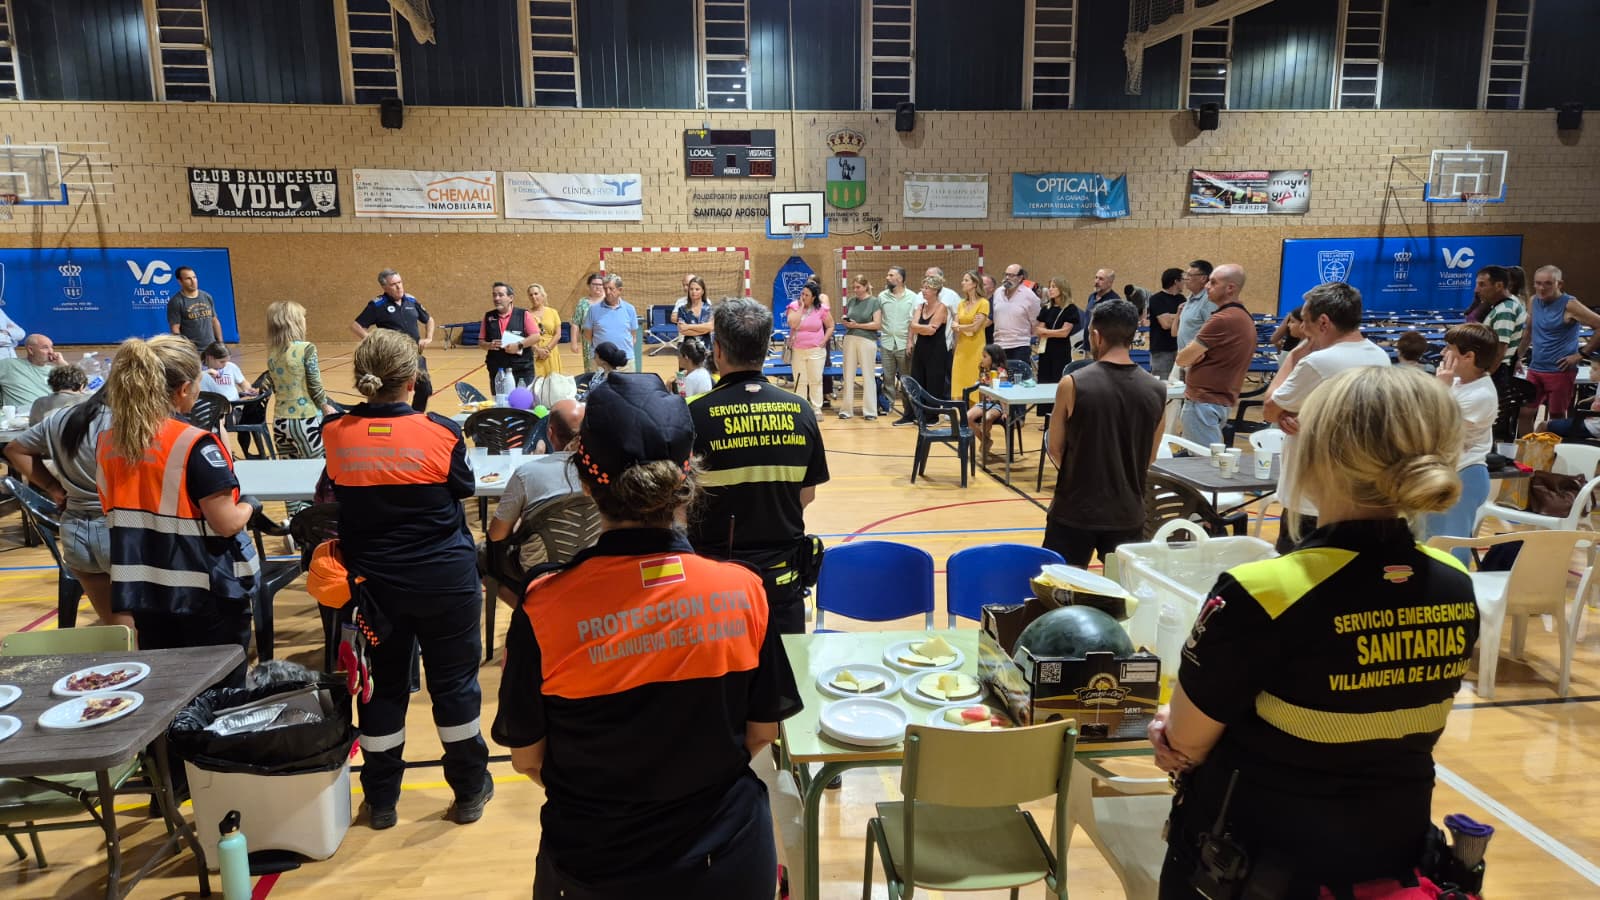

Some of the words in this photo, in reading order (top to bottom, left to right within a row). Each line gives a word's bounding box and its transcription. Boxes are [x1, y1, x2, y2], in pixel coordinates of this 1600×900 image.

[690, 149, 714, 157] LOCAL
[193, 169, 230, 182] CLUB
[237, 170, 333, 183] BALONCESTO
[1036, 177, 1107, 195] OPTICALA
[228, 184, 302, 209] VDLC
[217, 208, 320, 217] Basketlacanada.com
[428, 202, 492, 210] INMOBILIARIA
[694, 207, 732, 217] SANTIAGO
[143, 296, 170, 304] Cañad
[709, 403, 748, 417] SERVICIO
[750, 402, 801, 413] EMERGENCIAS
[724, 414, 794, 434] SANITARIAS
[710, 436, 758, 451] VILLANUEVA
[761, 435, 770, 445] DE
[771, 434, 781, 445] LA
[782, 432, 806, 445] CAÑADA
[577, 594, 705, 642] PROTECCION
[709, 590, 751, 613] CIVIL
[1334, 609, 1394, 634] SERVICIO
[1398, 602, 1475, 626] EMERGENCIAS
[588, 631, 667, 664] VILLANUEVA
[669, 628, 686, 647] DE
[688, 625, 704, 644] LA
[707, 618, 747, 641] CAÑADA
[1357, 626, 1466, 666] SANITARIAS
[1329, 667, 1405, 691] VILLANUEVA
[1408, 665, 1424, 683] DE
[1426, 664, 1440, 681] LA
